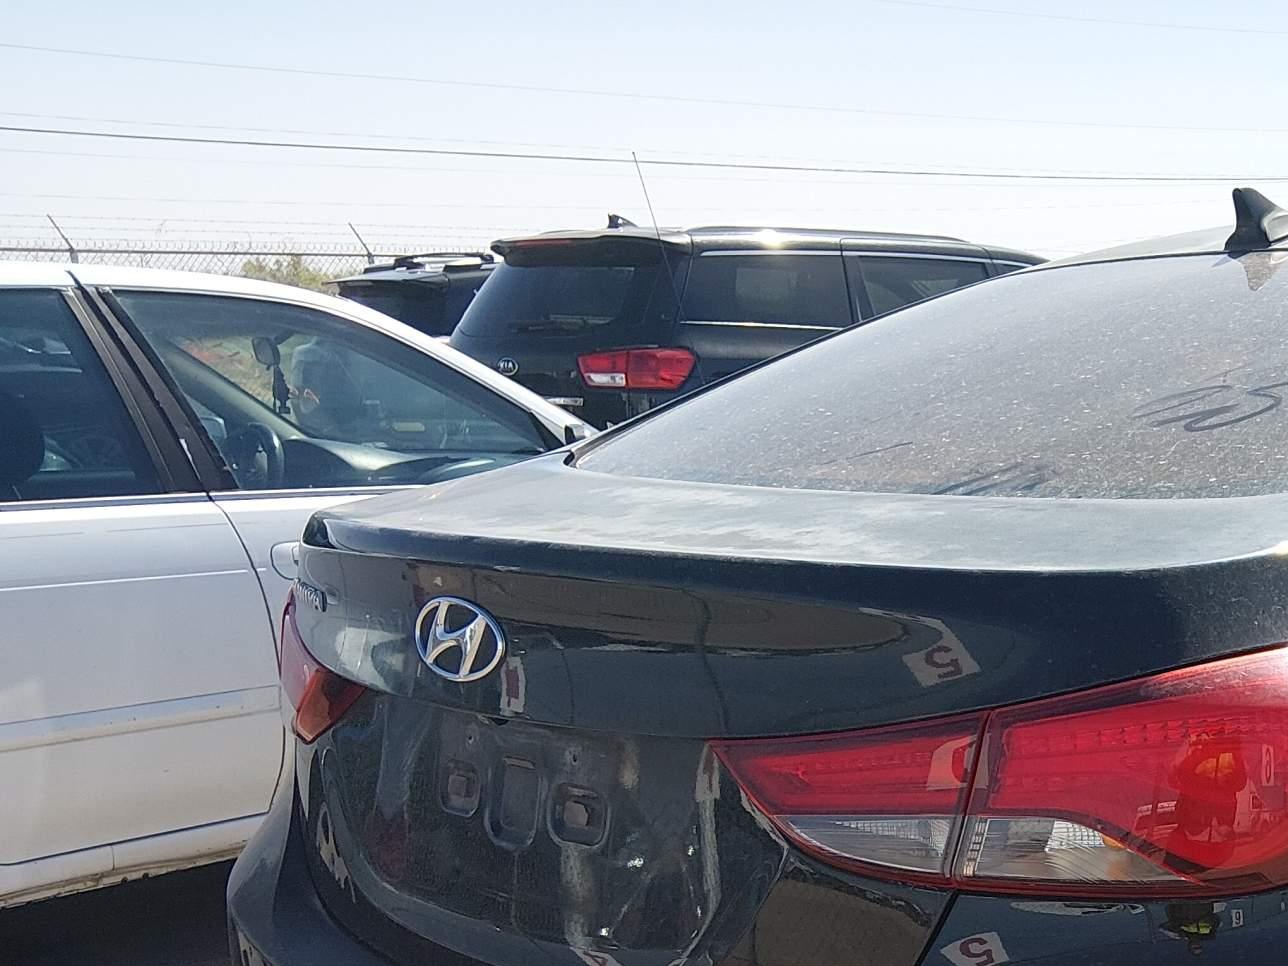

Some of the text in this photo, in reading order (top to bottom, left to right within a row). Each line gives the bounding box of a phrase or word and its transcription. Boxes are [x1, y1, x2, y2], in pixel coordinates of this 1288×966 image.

[499, 360, 514, 370] KIA
[925, 645, 963, 679] 5
[959, 938, 994, 966] 5
